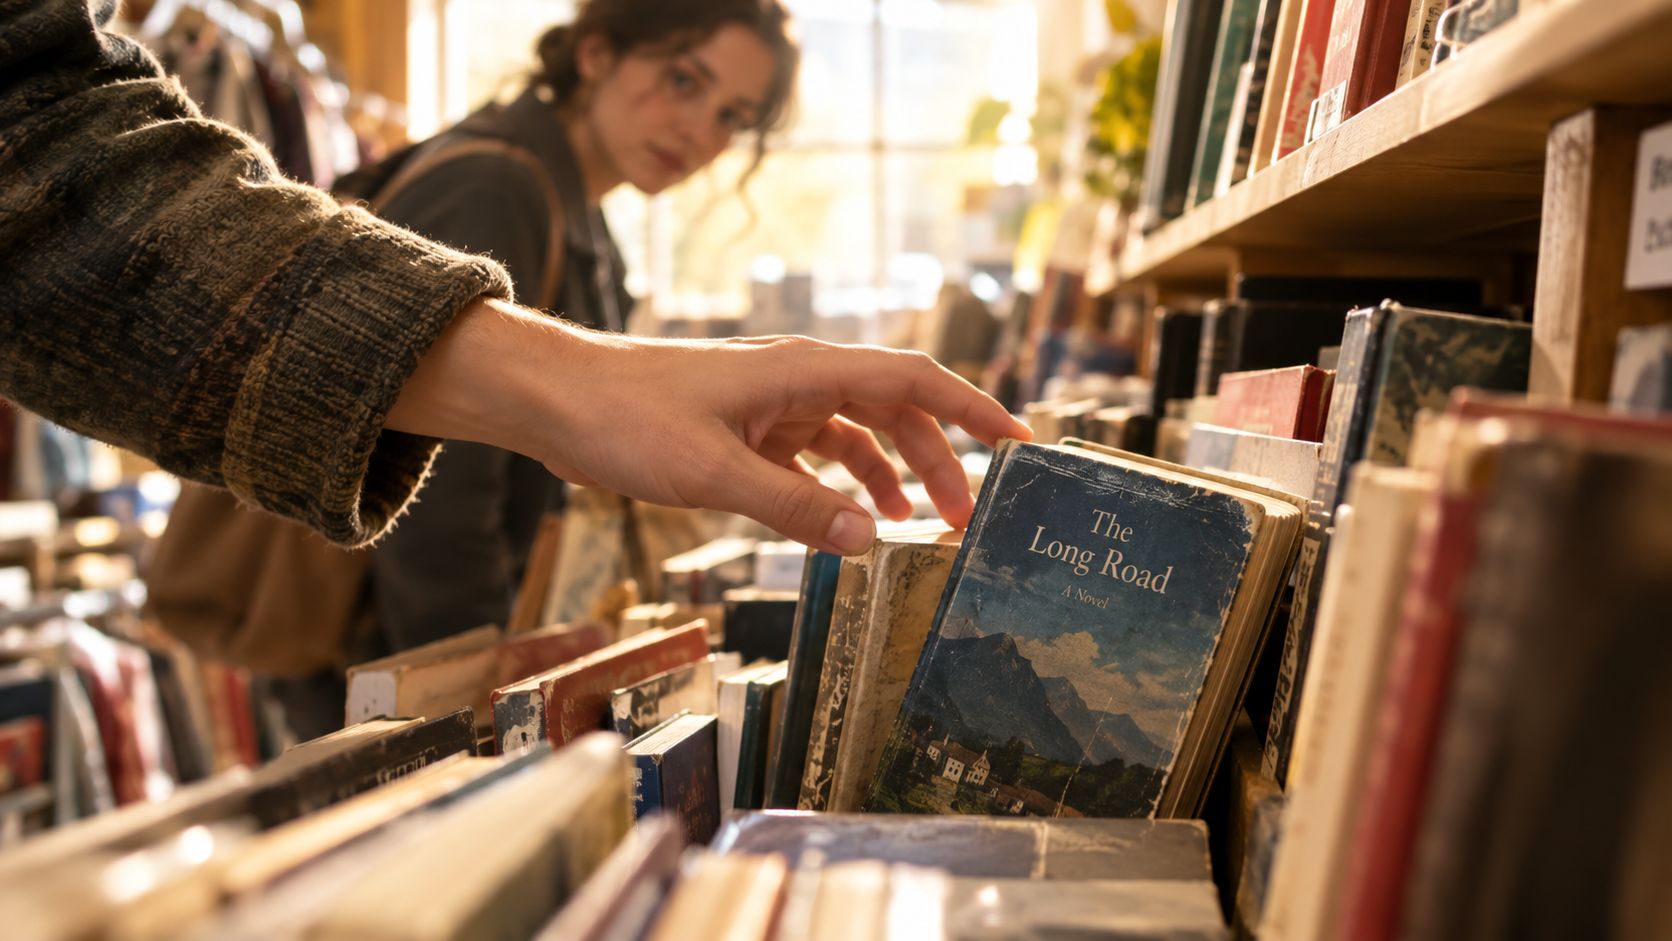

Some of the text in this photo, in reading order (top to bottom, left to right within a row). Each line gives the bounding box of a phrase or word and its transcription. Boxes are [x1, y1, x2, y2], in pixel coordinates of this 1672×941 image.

[1091, 509, 1134, 543] The
[1028, 526, 1174, 594] Long Road
[1061, 584, 1110, 610] A Novel
